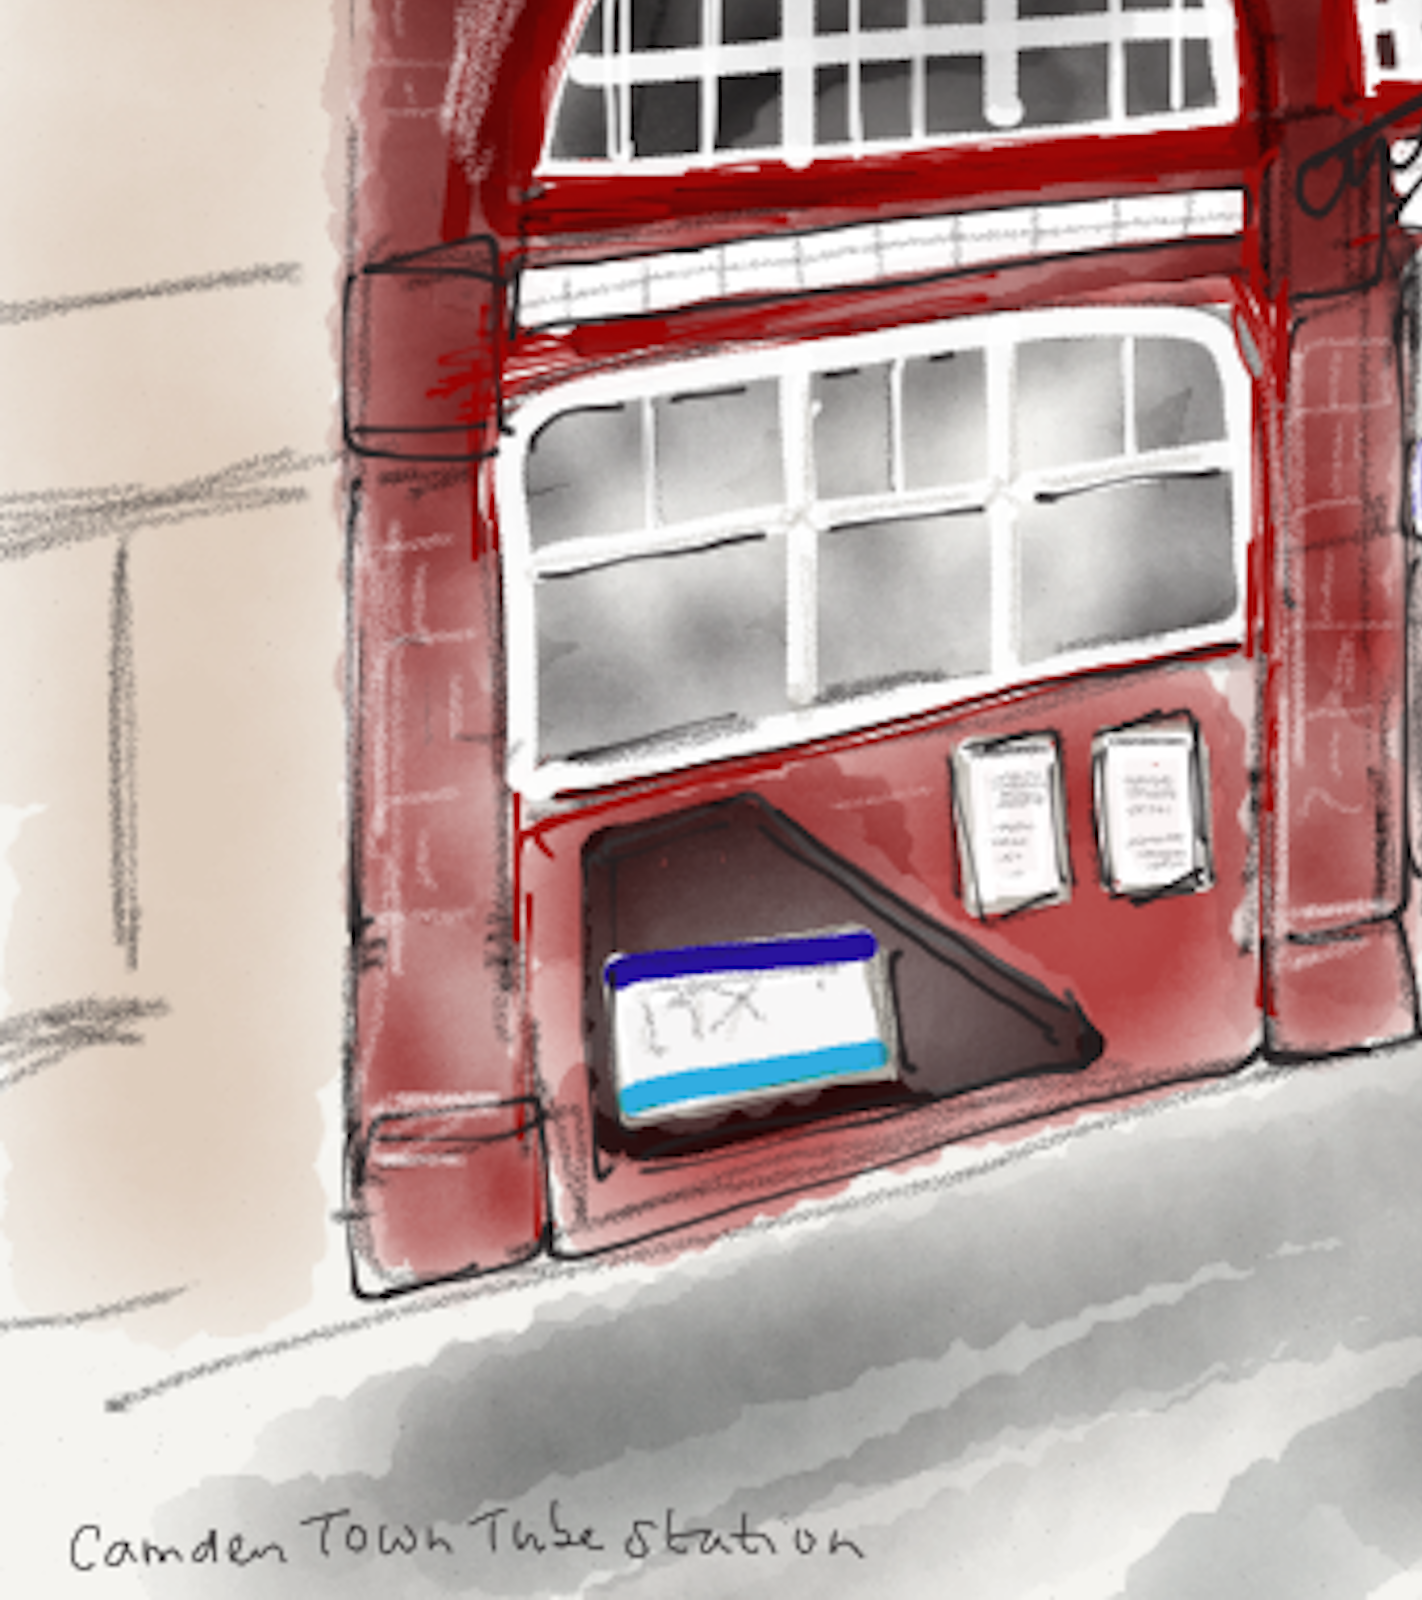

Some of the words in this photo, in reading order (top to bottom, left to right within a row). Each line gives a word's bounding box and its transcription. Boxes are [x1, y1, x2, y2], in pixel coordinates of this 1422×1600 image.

[70, 1523, 289, 1571] Camden
[299, 1507, 454, 1557] Town
[467, 1499, 605, 1554] Tube
[623, 1507, 866, 1560] Station
